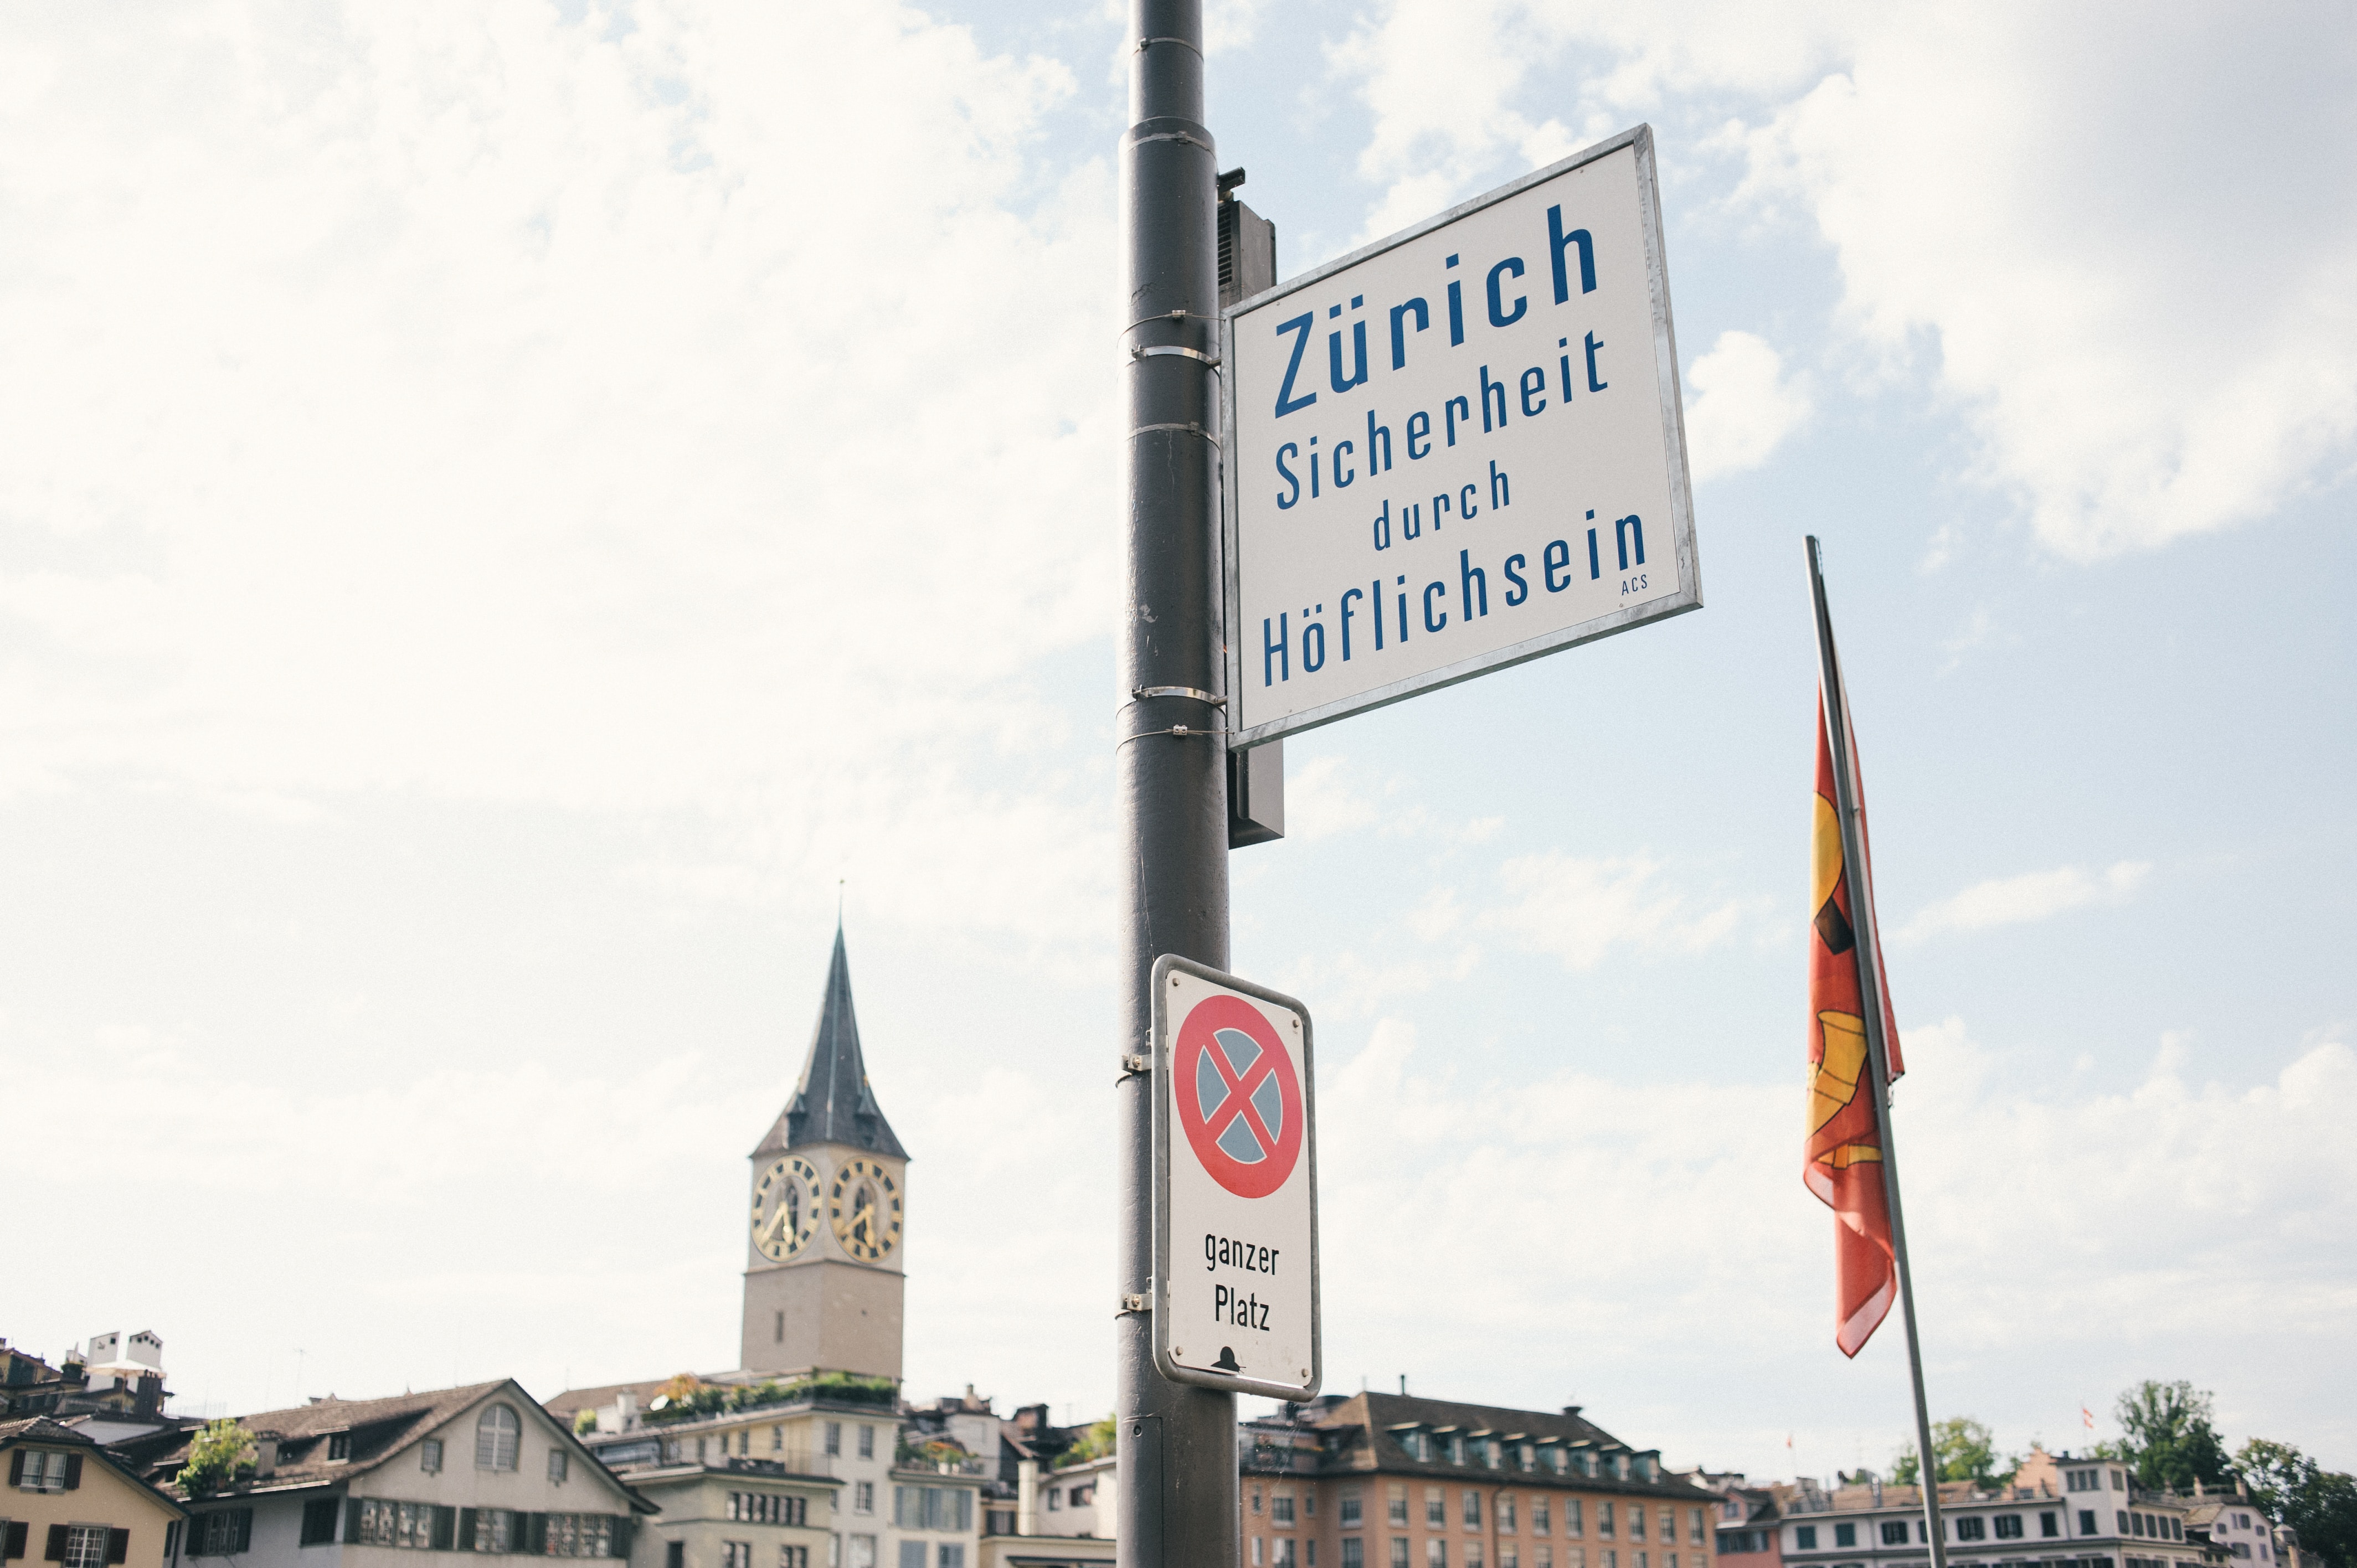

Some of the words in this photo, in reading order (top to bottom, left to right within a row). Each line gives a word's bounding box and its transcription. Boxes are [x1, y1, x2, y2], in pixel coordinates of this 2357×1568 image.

[1275, 203, 1597, 419] Zürich
[1275, 330, 1608, 510] Sicherheit
[1373, 460, 1510, 551] durch
[1263, 509, 1645, 687] Höflichsein
[1622, 574, 1648, 596] ACS
[1205, 1233, 1280, 1276] ganzer
[1215, 1283, 1270, 1332] Platz
